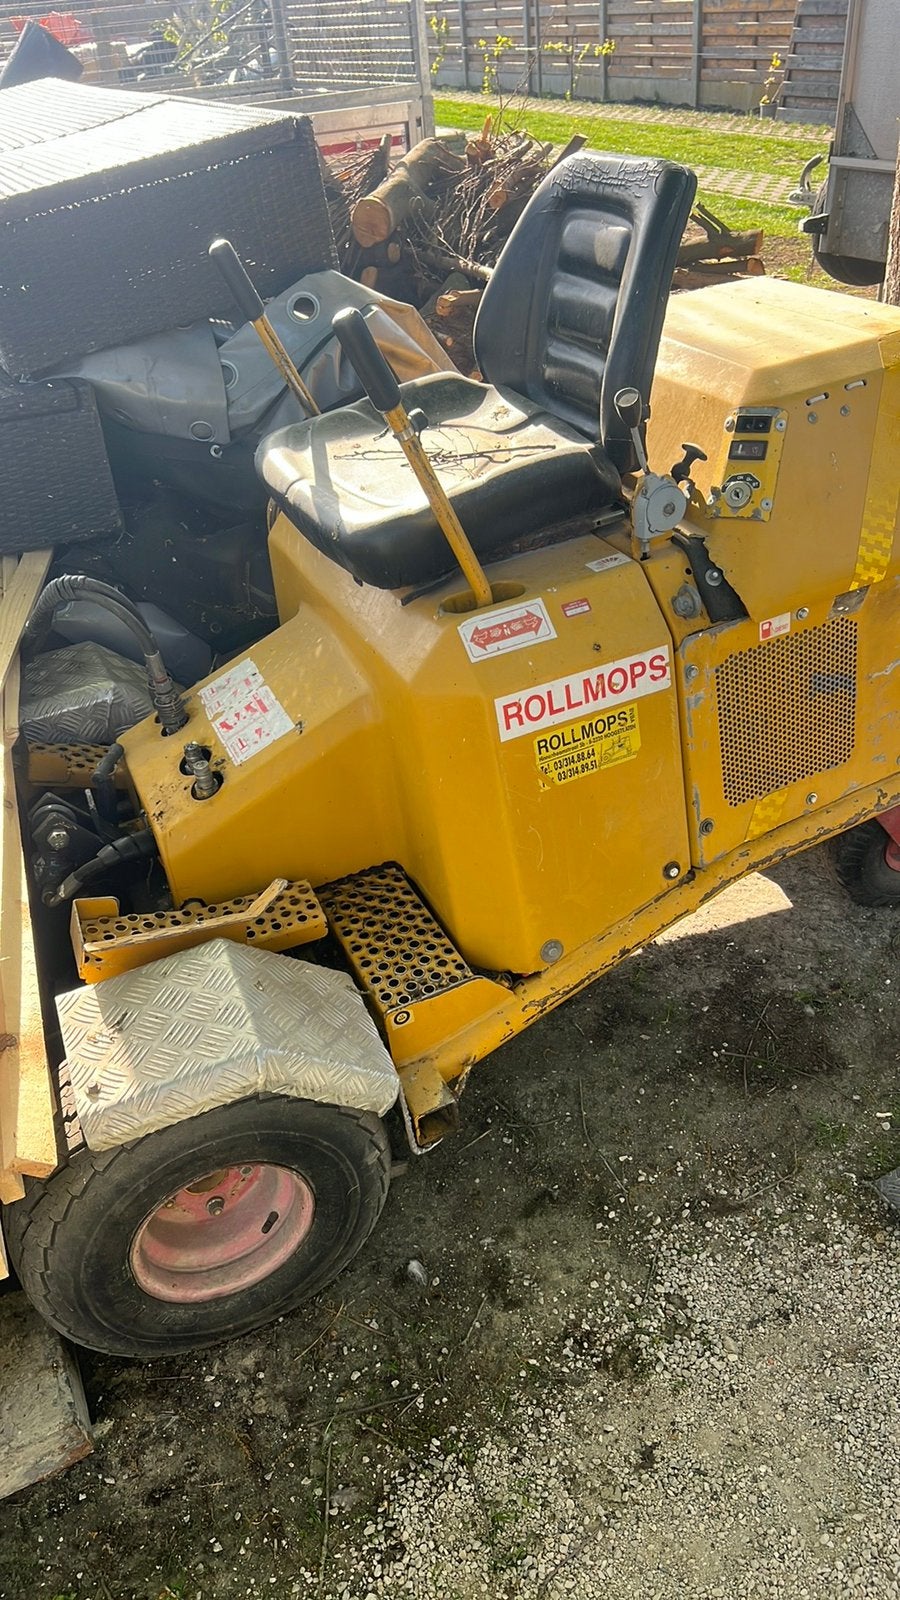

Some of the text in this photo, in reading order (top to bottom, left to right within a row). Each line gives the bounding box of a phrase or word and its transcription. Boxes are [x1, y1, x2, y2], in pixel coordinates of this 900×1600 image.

[502, 654, 668, 731] ROLLMOPS
[537, 711, 628, 755] ROLLMOPS
[553, 748, 596, 771] 03/314.88.64
[557, 759, 598, 782] 03/314.89.51
